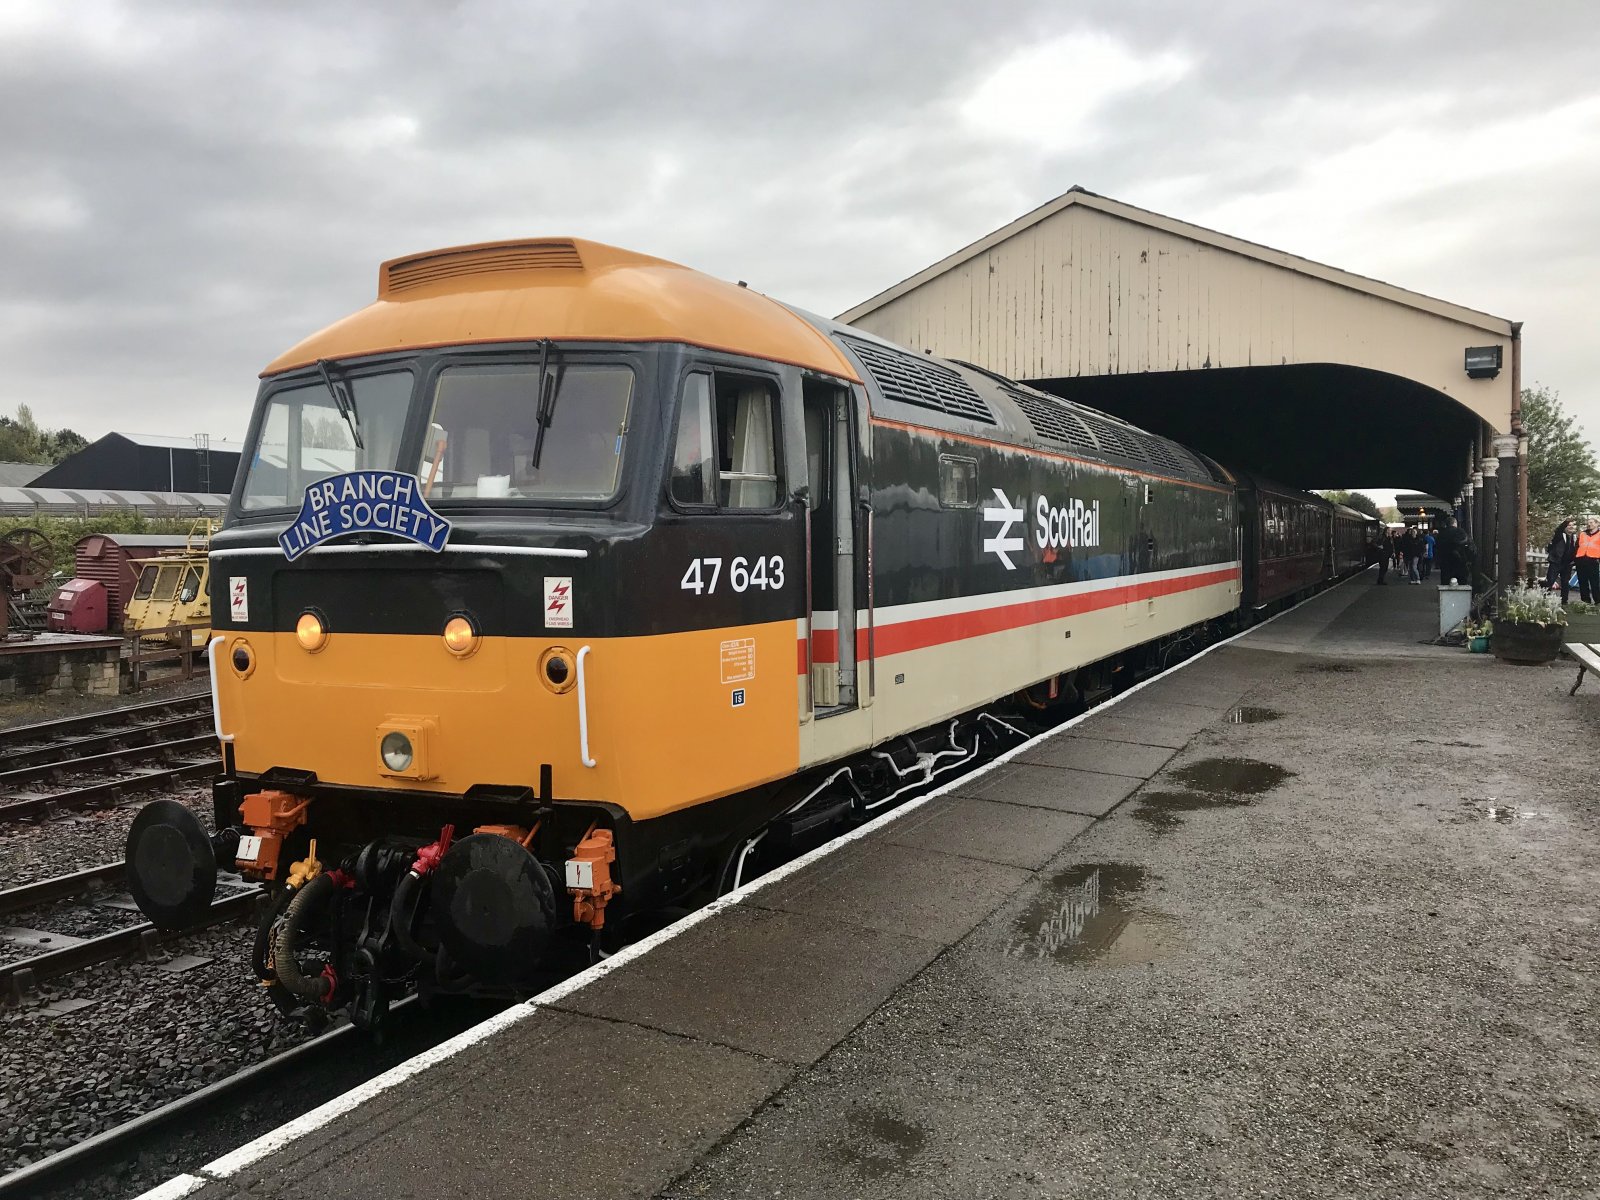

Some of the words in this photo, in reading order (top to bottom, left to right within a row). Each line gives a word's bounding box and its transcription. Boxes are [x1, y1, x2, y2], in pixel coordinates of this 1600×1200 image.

[308, 475, 414, 512] BRANCH
[282, 510, 333, 557] LINE
[340, 502, 447, 545] SOCIETY
[1036, 494, 1100, 549] ScotRail
[681, 558, 722, 595] 47
[730, 555, 785, 593] 643
